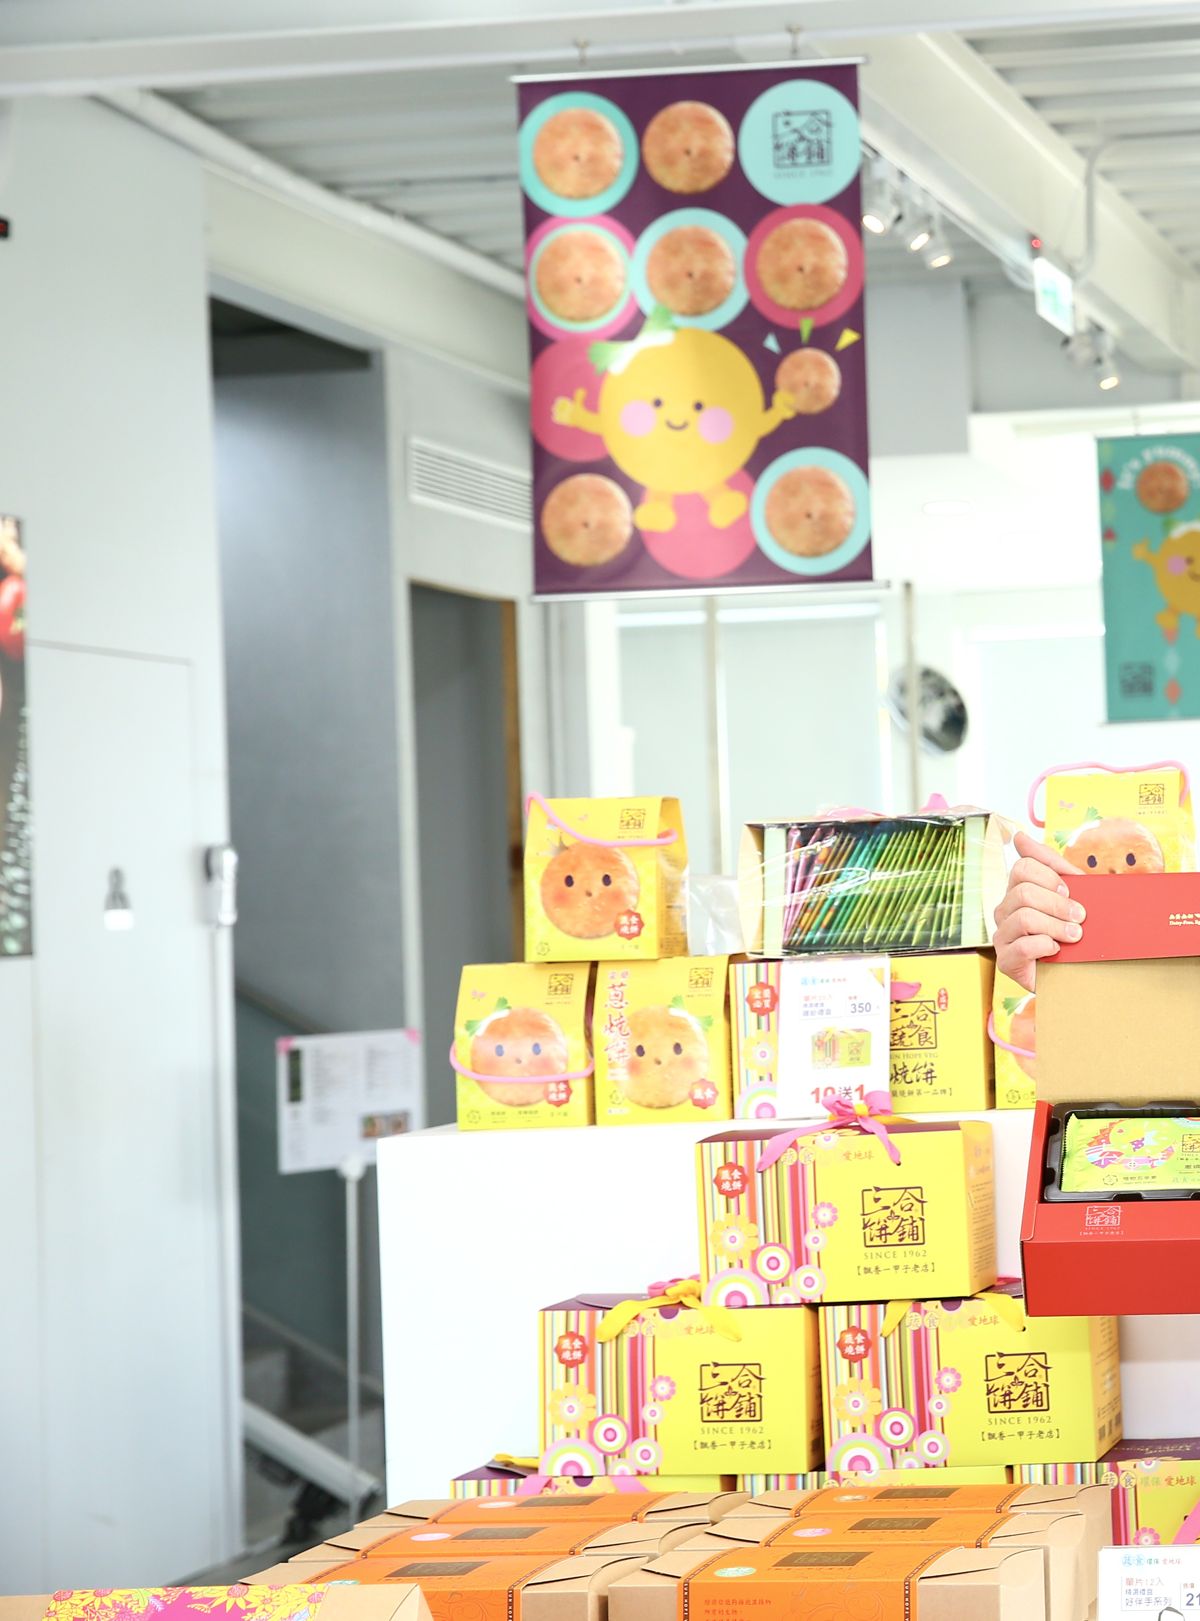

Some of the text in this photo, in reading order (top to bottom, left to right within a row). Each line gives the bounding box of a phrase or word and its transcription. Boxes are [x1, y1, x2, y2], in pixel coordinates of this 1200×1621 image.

[851, 1001, 872, 1013] 350
[863, 1250, 928, 1260] SINCE 1962
[987, 1415, 1053, 1426] SINCE 1962
[700, 1426, 765, 1435] SINCE 1962
[1163, 1474, 1198, 1487] 愛地球
